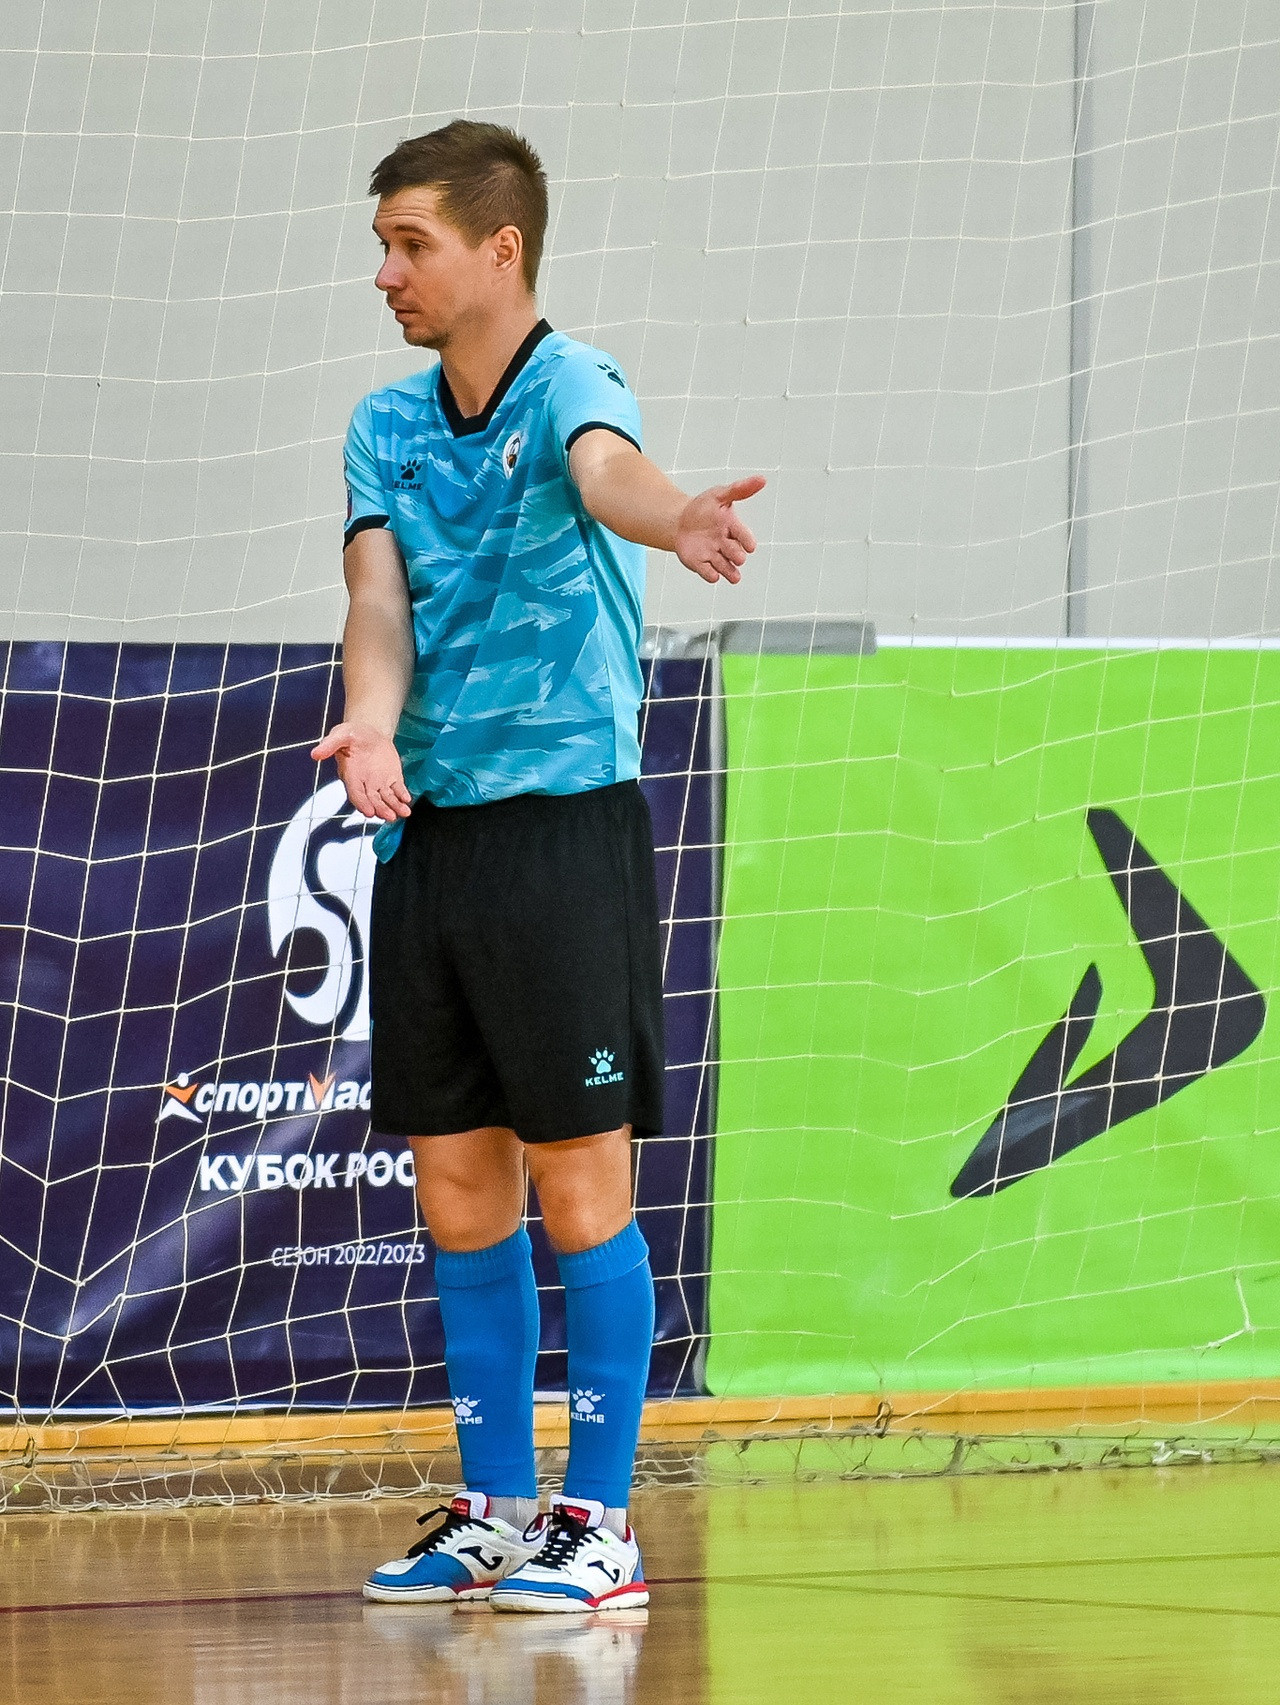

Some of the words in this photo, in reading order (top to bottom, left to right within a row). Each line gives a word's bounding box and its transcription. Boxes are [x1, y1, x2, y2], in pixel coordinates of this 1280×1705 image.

[392, 480, 424, 491] ELME
[585, 1072, 624, 1087] KELME
[200, 1153, 340, 1191] КУБОК
[272, 1247, 330, 1266] СЕЗОН
[334, 1242, 426, 1265] 2022/2023
